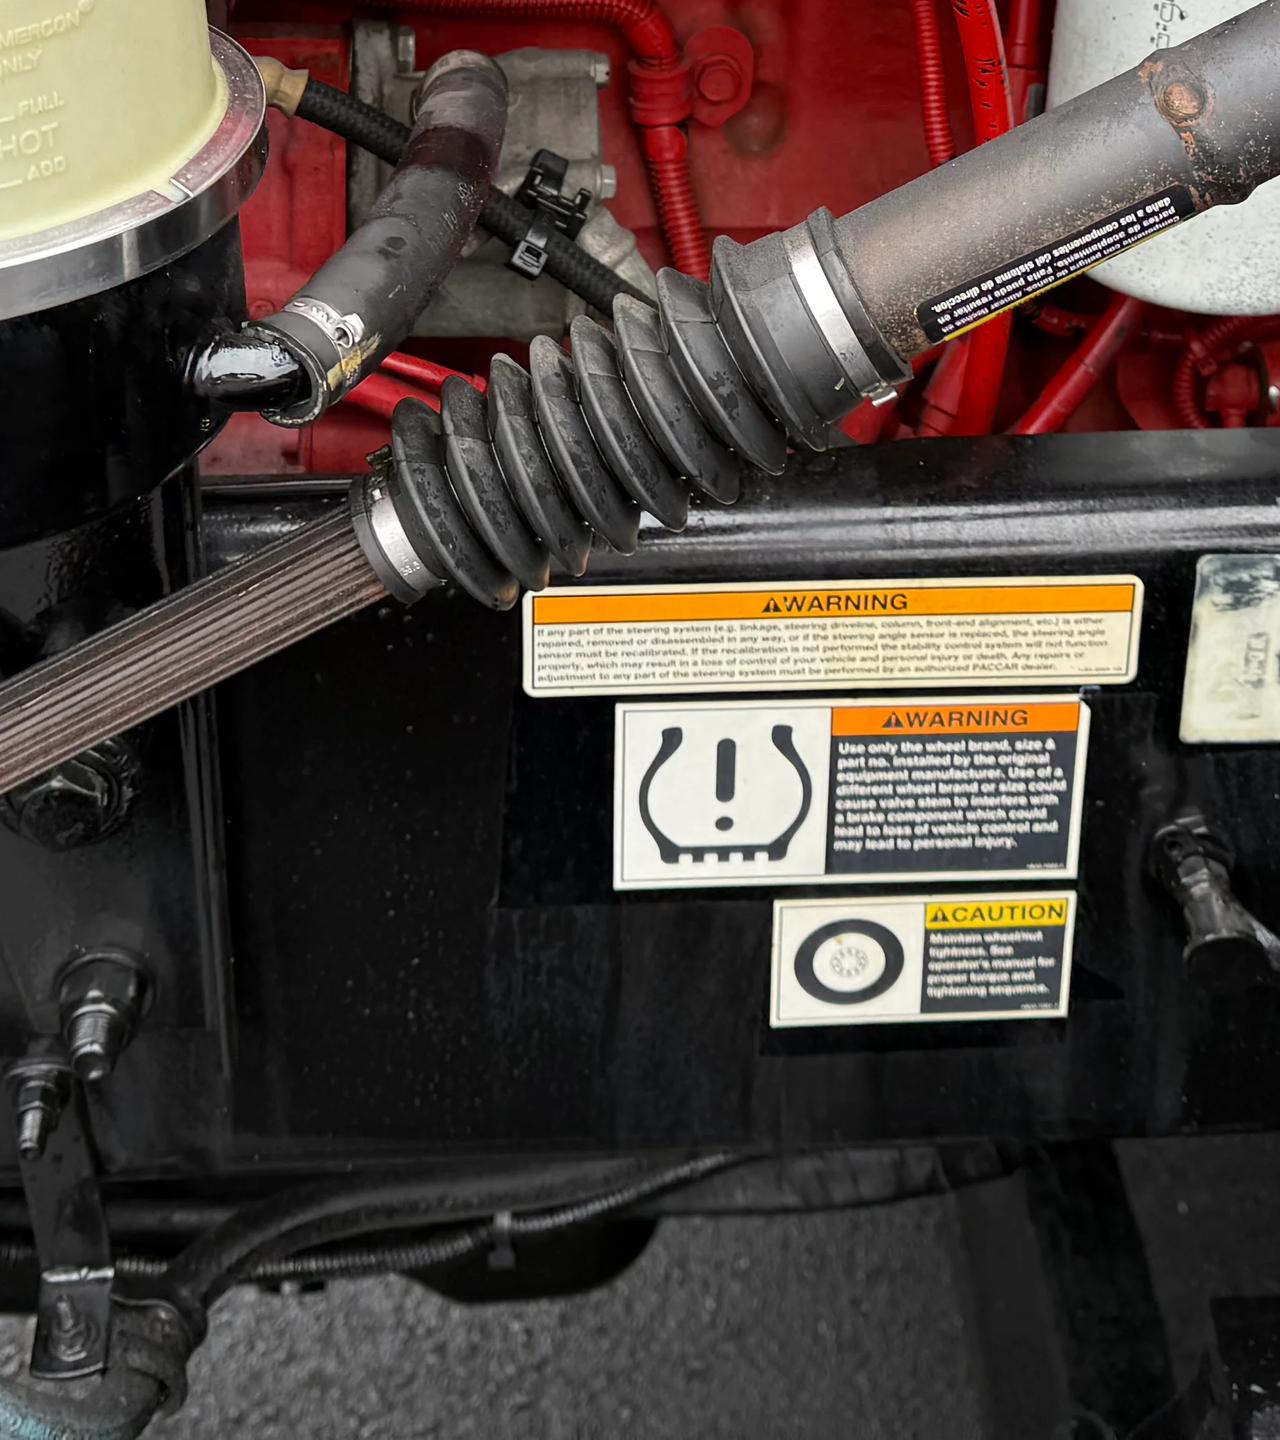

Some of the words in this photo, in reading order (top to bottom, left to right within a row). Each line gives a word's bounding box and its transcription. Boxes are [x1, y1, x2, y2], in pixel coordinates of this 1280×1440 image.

[18, 92, 64, 116] FULL
[28, 156, 66, 180] ADD
[1120, 213, 1136, 225] los
[1137, 209, 1144, 217] a
[1052, 222, 1118, 257] componentes
[995, 261, 1034, 284] sistema
[783, 593, 908, 612] WARNING
[906, 710, 1028, 727] WARNING
[839, 742, 865, 754] Use
[869, 742, 897, 755] only
[901, 741, 923, 753] the
[926, 740, 966, 753] wheel
[1015, 739, 1043, 750] size
[838, 756, 865, 769] part
[869, 757, 890, 768] no.
[893, 754, 950, 767] installed
[954, 754, 970, 767] by
[974, 753, 994, 765] the
[998, 752, 1049, 766] original
[837, 770, 908, 783] equipment
[912, 768, 1005, 780] manufacturer.
[1008, 767, 1033, 779] Use
[1037, 766, 1050, 778] of
[1054, 768, 1063, 778] a
[836, 782, 893, 796] different
[896, 782, 936, 795] wheel
[939, 781, 978, 794] brand
[981, 782, 995, 793] or
[999, 780, 1026, 792] size
[1029, 779, 1066, 792] could
[836, 799, 876, 809] cause
[879, 797, 915, 808] valve
[918, 797, 951, 808] stem
[954, 796, 968, 807] to
[971, 795, 1028, 807] interfere
[1031, 794, 1059, 805] with
[835, 813, 844, 823] a
[847, 811, 884, 823] brake
[887, 810, 963, 824] component
[966, 809, 1007, 820] which
[1009, 808, 1047, 820] could
[834, 825, 863, 837] lead
[867, 825, 880, 836] to
[883, 824, 912, 835] loss
[915, 824, 929, 834] of
[932, 823, 979, 834] vehicle
[982, 821, 1030, 833] control
[1032, 820, 1058, 832] and
[834, 840, 862, 853] may
[865, 838, 894, 850] lead
[897, 838, 911, 849] to
[913, 837, 972, 851] personal
[975, 837, 1017, 850] injury.
[952, 904, 1063, 922] CAUTION
